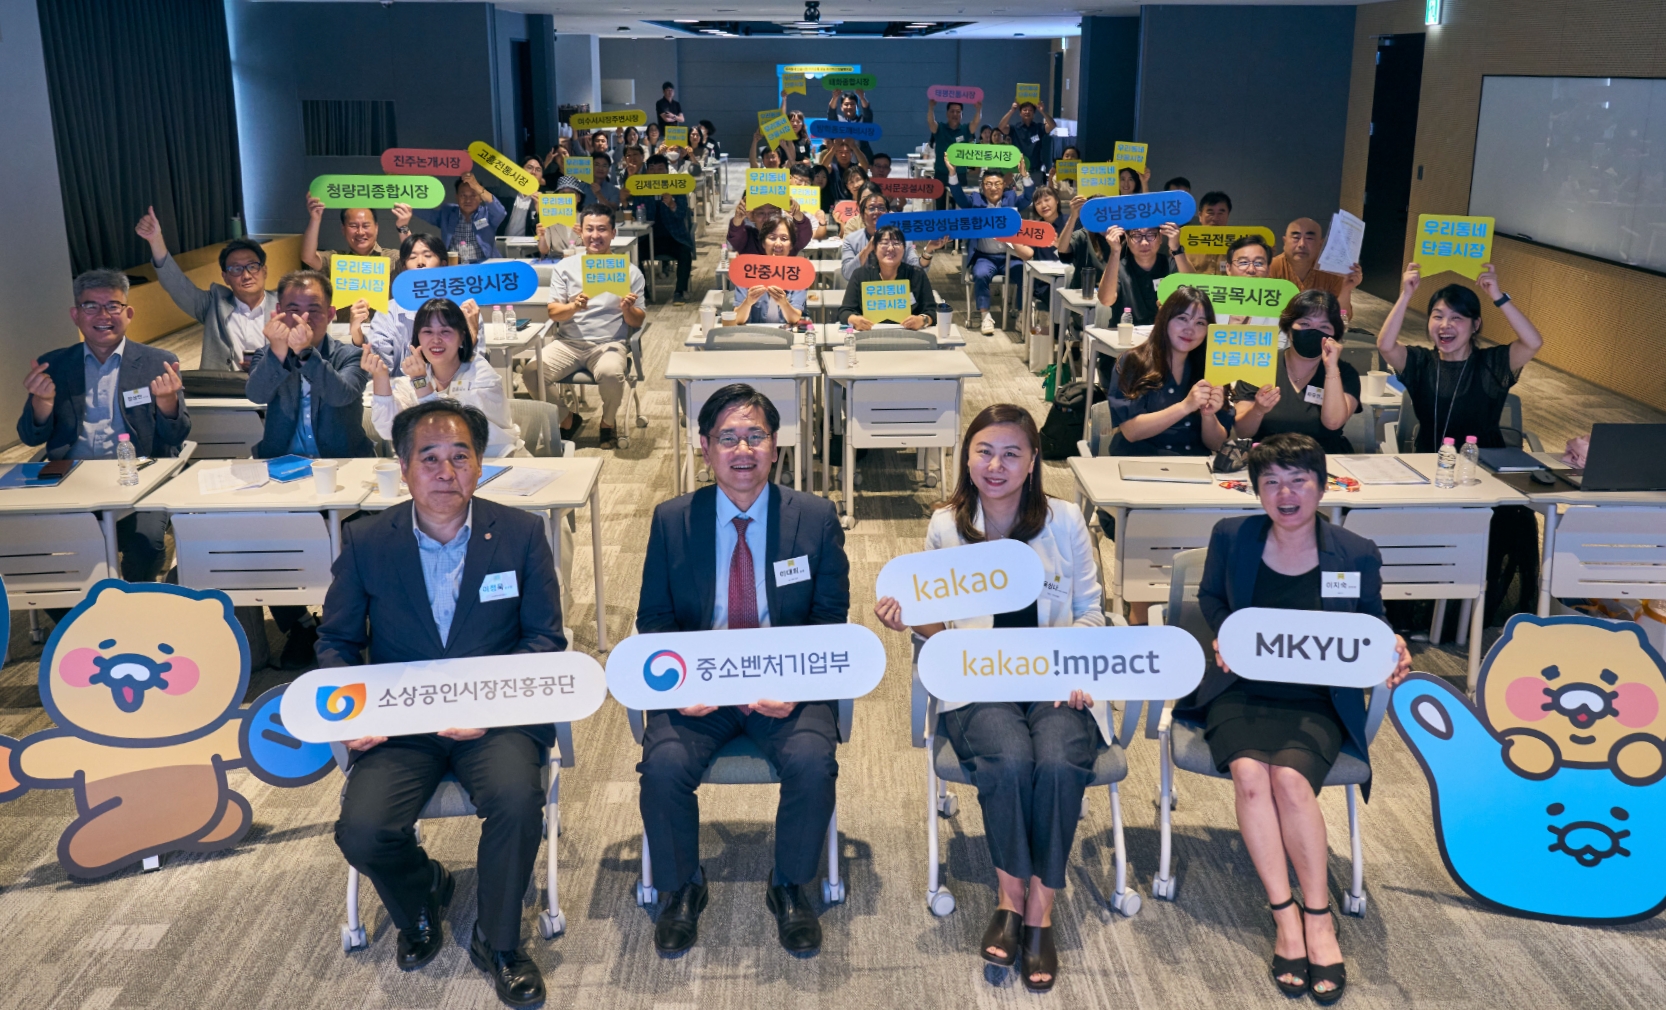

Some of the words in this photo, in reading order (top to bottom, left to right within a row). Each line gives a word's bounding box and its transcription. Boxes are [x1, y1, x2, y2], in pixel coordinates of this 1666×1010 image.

[577, 114, 639, 125] 여수서시장주변시장
[955, 149, 1013, 162] 괴산전통시장
[1117, 144, 1145, 153] 우리동네
[393, 155, 461, 169] 진주논개시장
[477, 149, 529, 187] 고흥전통시장
[750, 172, 787, 182] 우리동네
[1081, 165, 1116, 175] 우리동네
[635, 179, 687, 190] 김제전통시장
[1081, 177, 1116, 187] 단골시장
[326, 183, 429, 199] 청량리종합시장
[750, 185, 787, 196] 단골시장
[791, 188, 818, 196] 우리동네
[542, 197, 573, 205] 우리동네
[542, 208, 573, 216] 단골시장
[1094, 200, 1182, 222] 성남중앙시장
[1423, 220, 1488, 238] 우리동네
[1421, 240, 1486, 259] 단골시장
[336, 260, 385, 275] 우리동네
[585, 258, 626, 269] 우리동네
[585, 272, 626, 284] 단골시장
[743, 264, 801, 281] 안중시장
[335, 277, 385, 293] 단골시장
[411, 272, 519, 299] 문경중앙시장
[866, 284, 906, 296] 우리동네
[866, 299, 907, 311] 단골시장
[1213, 330, 1273, 347] 우리동네
[1212, 351, 1272, 368] 단골시장
[912, 568, 1009, 602] kakao
[1256, 632, 1360, 663] MKYU
[696, 651, 850, 681] 중소벤처기업부
[962, 649, 1161, 681] kakao!mpact
[378, 674, 576, 709] 소상공인시장진흥공단
